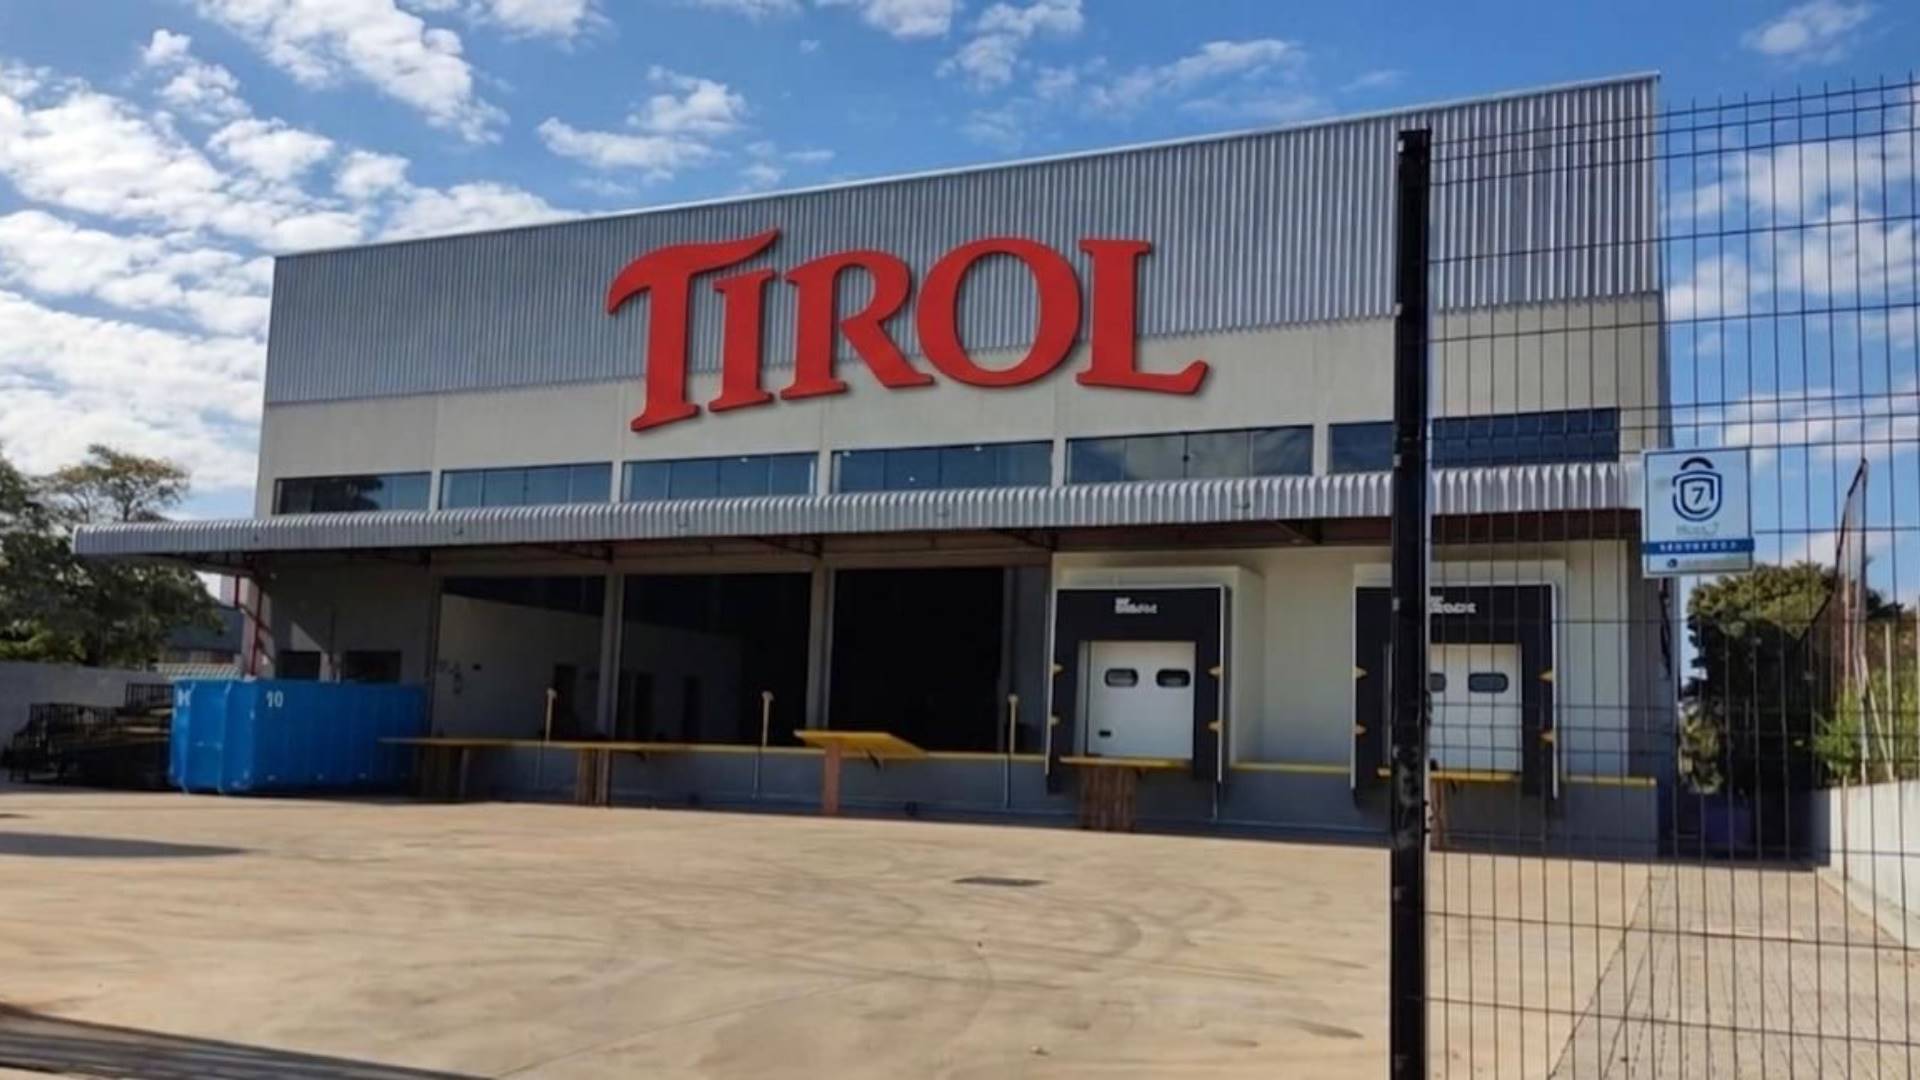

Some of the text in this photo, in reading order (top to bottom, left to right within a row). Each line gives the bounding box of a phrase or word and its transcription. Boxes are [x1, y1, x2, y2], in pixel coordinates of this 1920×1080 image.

[607, 228, 1210, 432] TIROL
[1691, 486, 1705, 505] 7
[266, 690, 284, 708] 10
